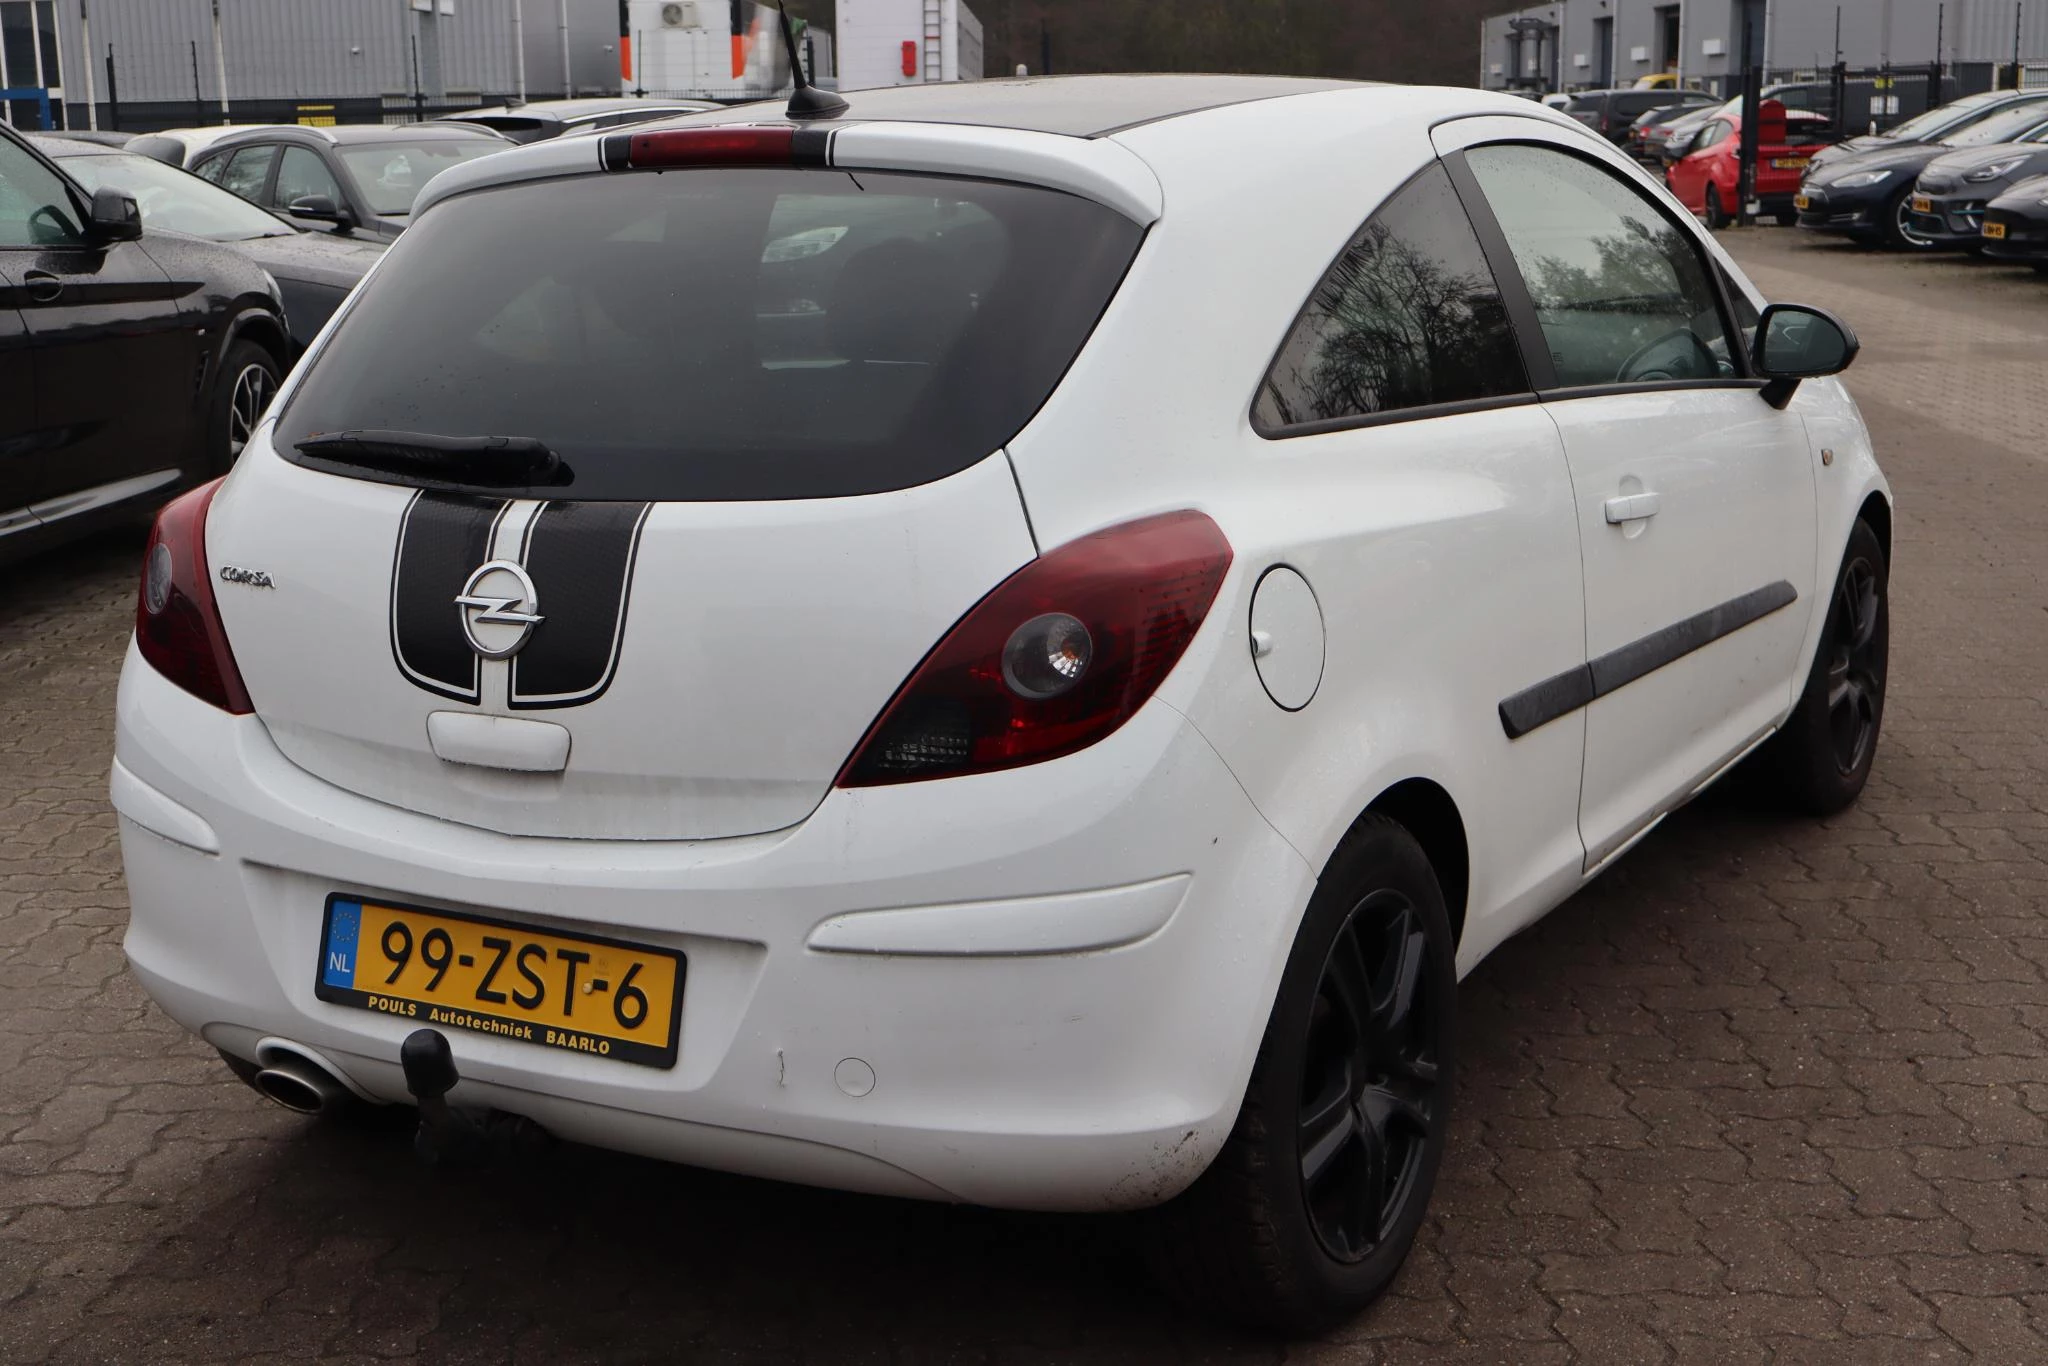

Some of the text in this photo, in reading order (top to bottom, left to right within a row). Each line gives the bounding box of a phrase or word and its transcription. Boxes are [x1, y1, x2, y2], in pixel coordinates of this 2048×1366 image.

[329, 952, 351, 973] NL
[381, 920, 648, 1029] 99-ZST-6
[368, 995, 610, 1055] POULS Autotechniek BAARLO
